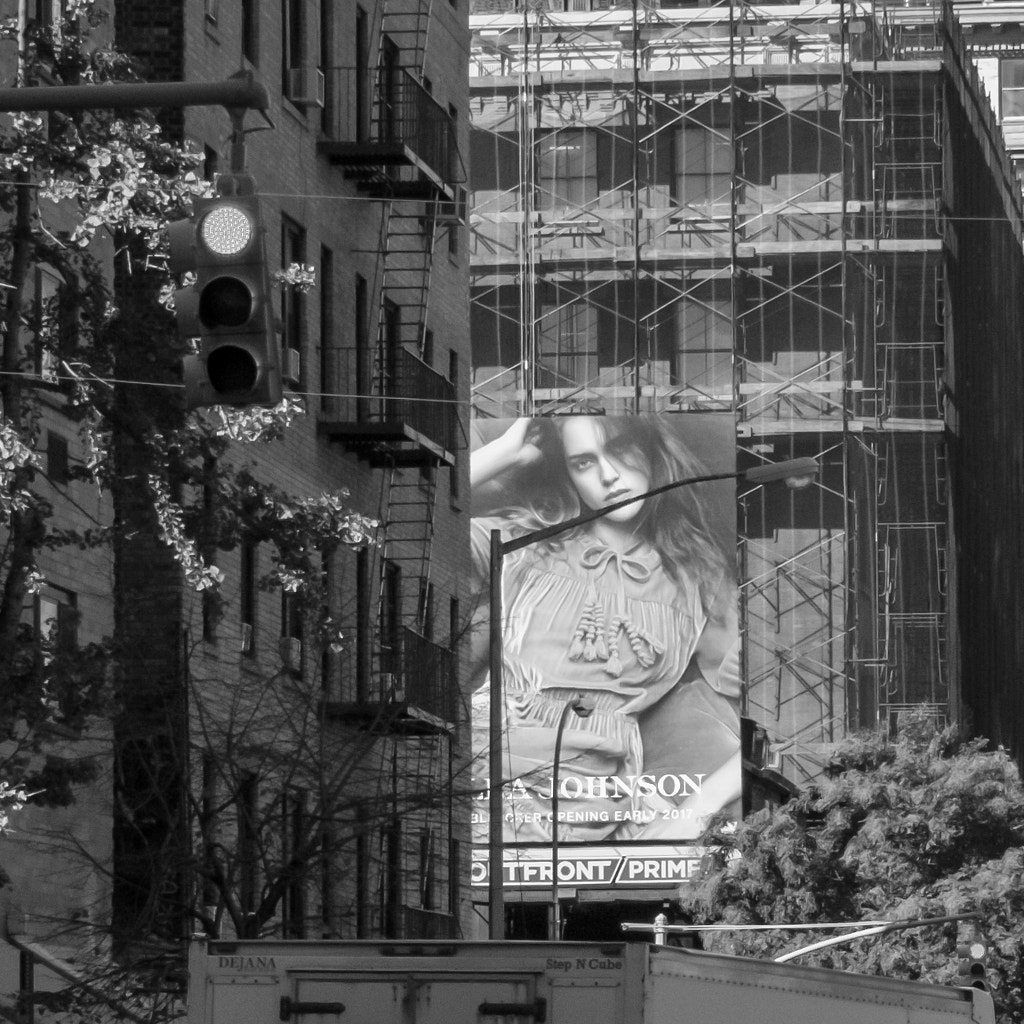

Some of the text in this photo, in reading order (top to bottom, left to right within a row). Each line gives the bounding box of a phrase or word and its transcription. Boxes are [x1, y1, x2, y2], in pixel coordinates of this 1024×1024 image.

[537, 773, 707, 800] JOHNSON
[614, 808, 656, 822] EARLY
[662, 808, 694, 820] 2017
[470, 860, 612, 882] OTFRONT
[218, 956, 277, 970] DEJANA
[546, 958, 623, 972] Step N Cube
